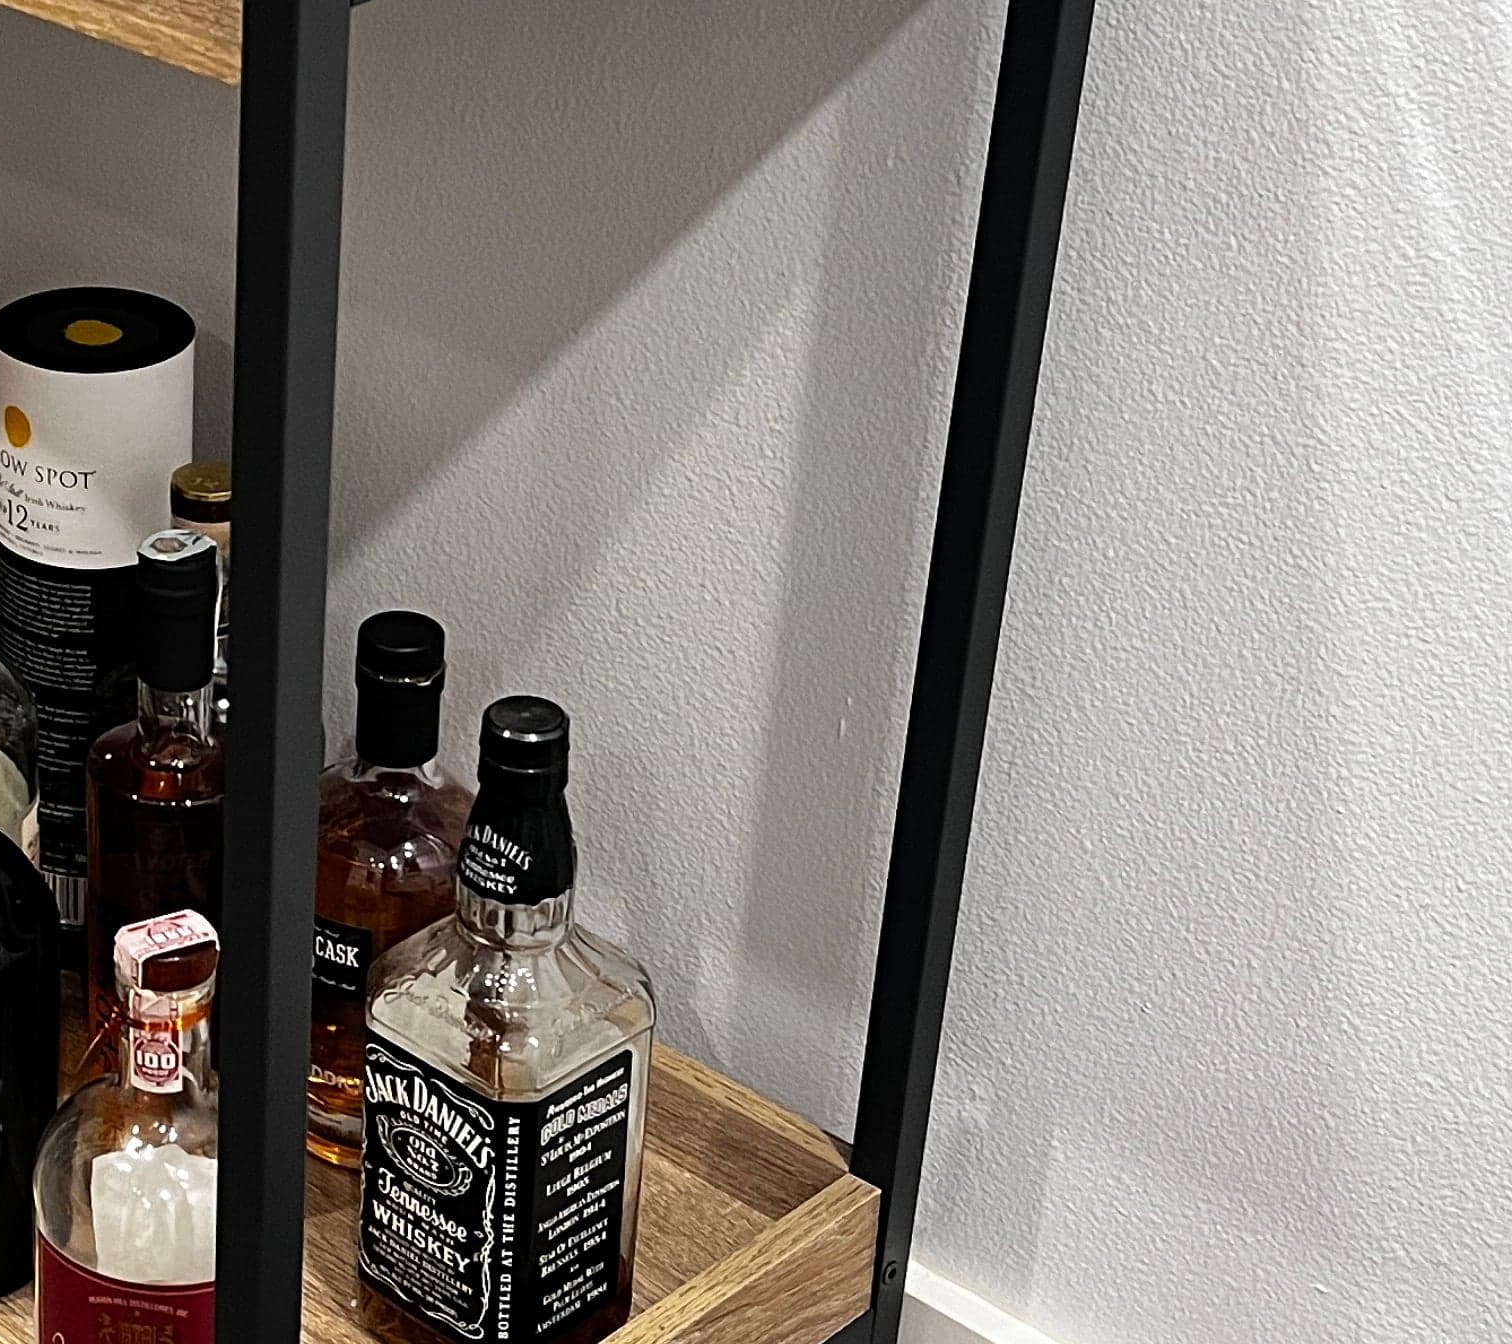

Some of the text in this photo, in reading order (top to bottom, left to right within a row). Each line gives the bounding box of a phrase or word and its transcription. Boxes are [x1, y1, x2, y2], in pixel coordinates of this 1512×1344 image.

[35, 465, 97, 490] SPOT
[7, 499, 28, 532] 12
[315, 935, 359, 968] CASK
[136, 1050, 176, 1070] 100
[366, 1065, 410, 1108] JACK
[413, 1076, 495, 1169] DANIEL'S
[400, 1110, 420, 1124] OLD
[540, 1108, 575, 1146] GOLD
[378, 1167, 468, 1243] Tennessee
[372, 1200, 470, 1273] WHISKEY
[498, 1117, 521, 1339] BOTTLED AT THE DISTILLERY
